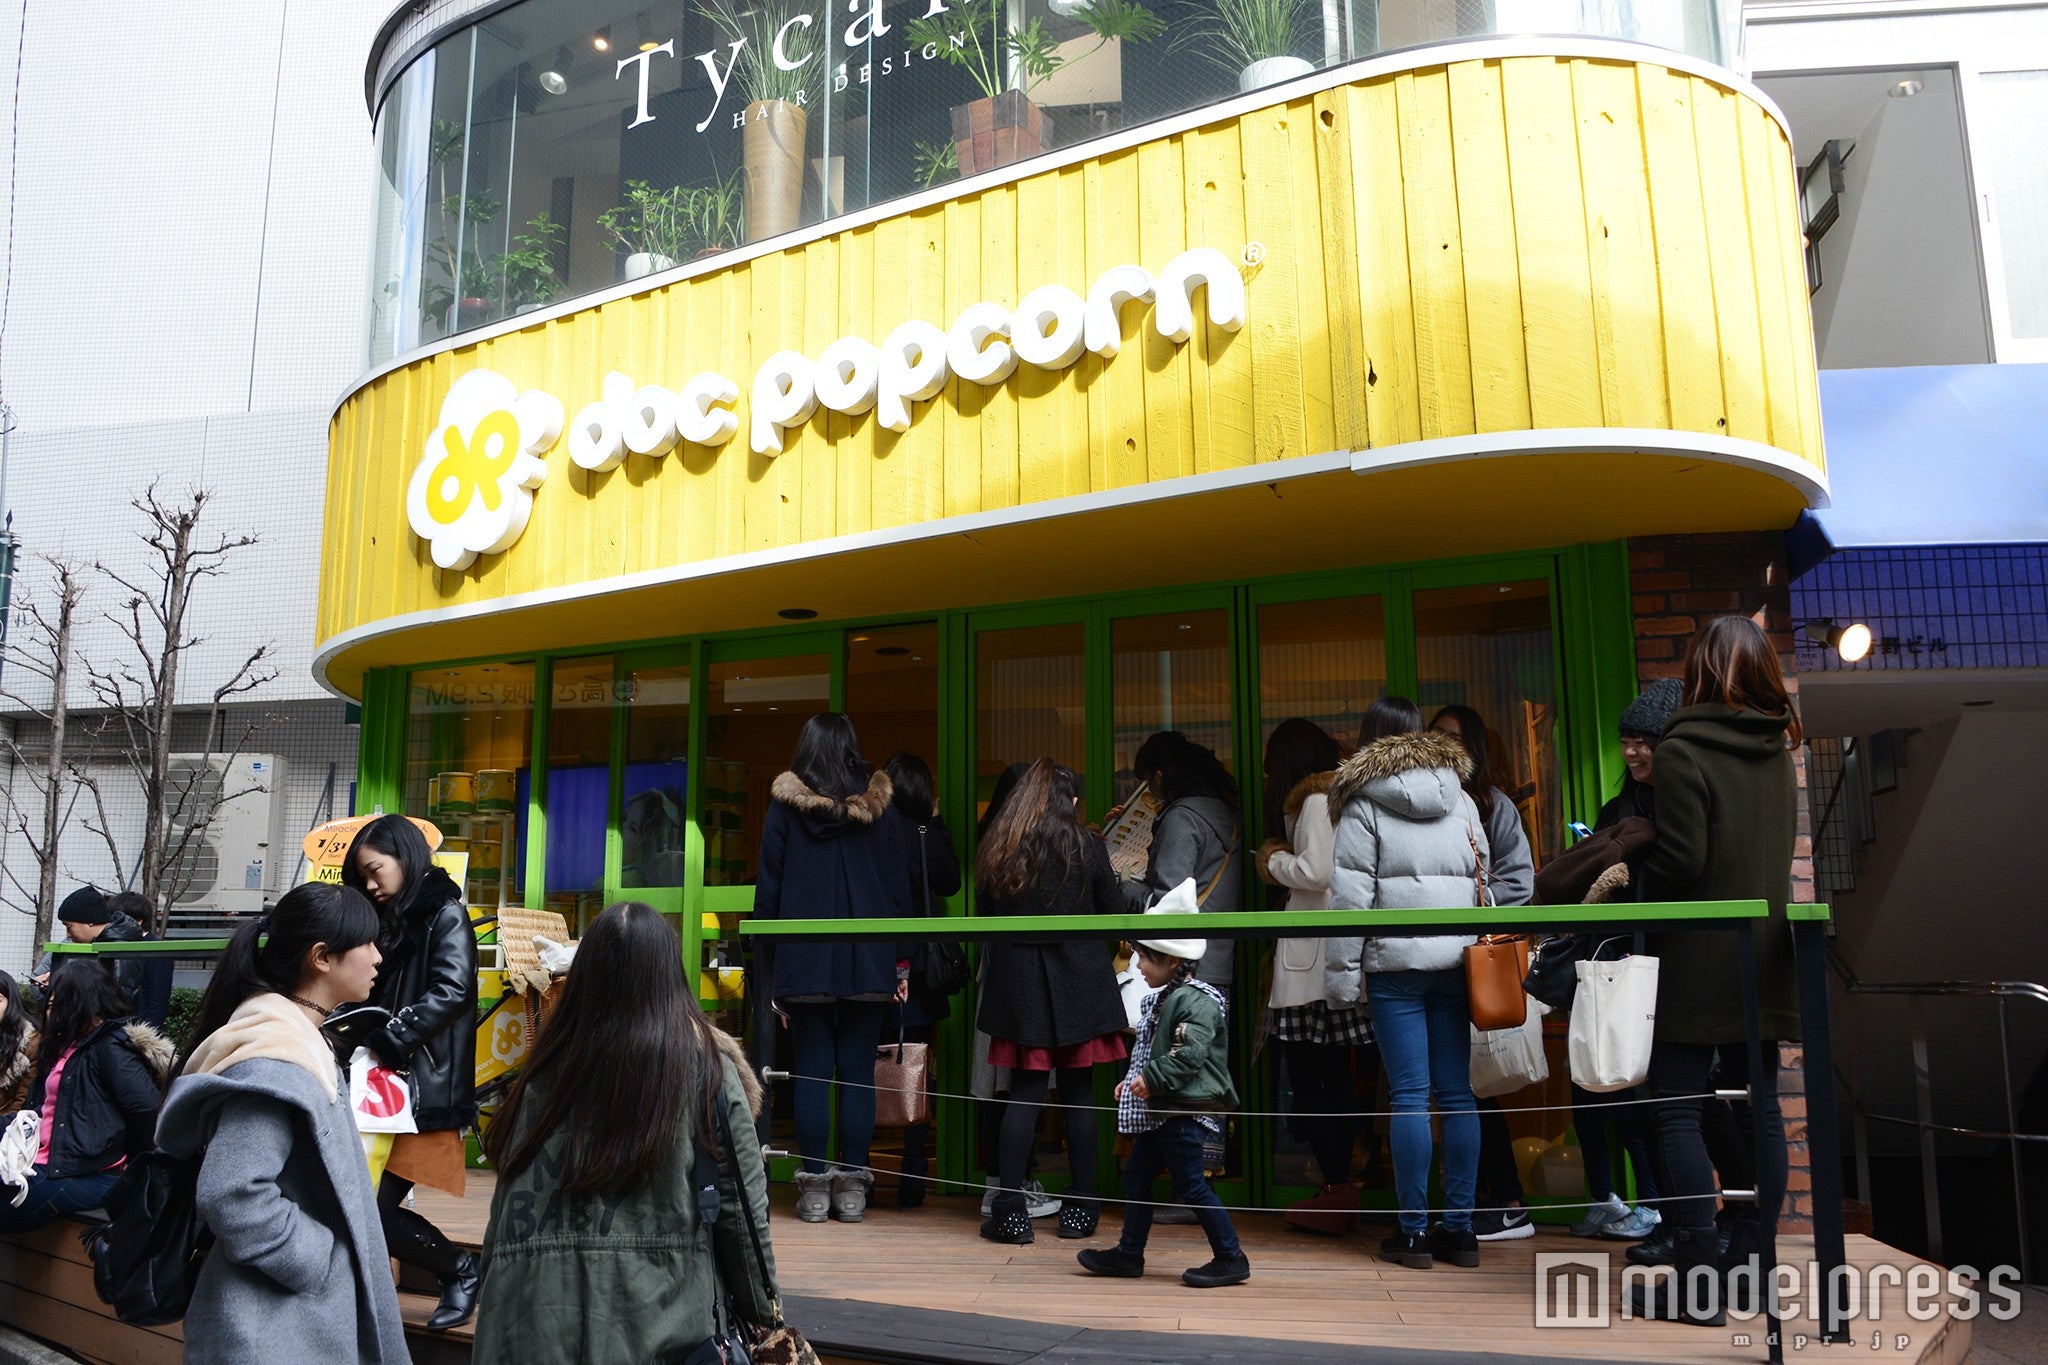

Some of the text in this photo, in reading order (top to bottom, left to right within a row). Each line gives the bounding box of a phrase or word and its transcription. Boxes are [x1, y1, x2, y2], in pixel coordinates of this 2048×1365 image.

[732, 31, 966, 130] HAIR DESIGN
[567, 369, 740, 473] doc
[750, 246, 1247, 459] popcorn
[316, 832, 347, 861] 1/31
[323, 824, 358, 834] Miracle
[507, 1187, 629, 1241] BABY
